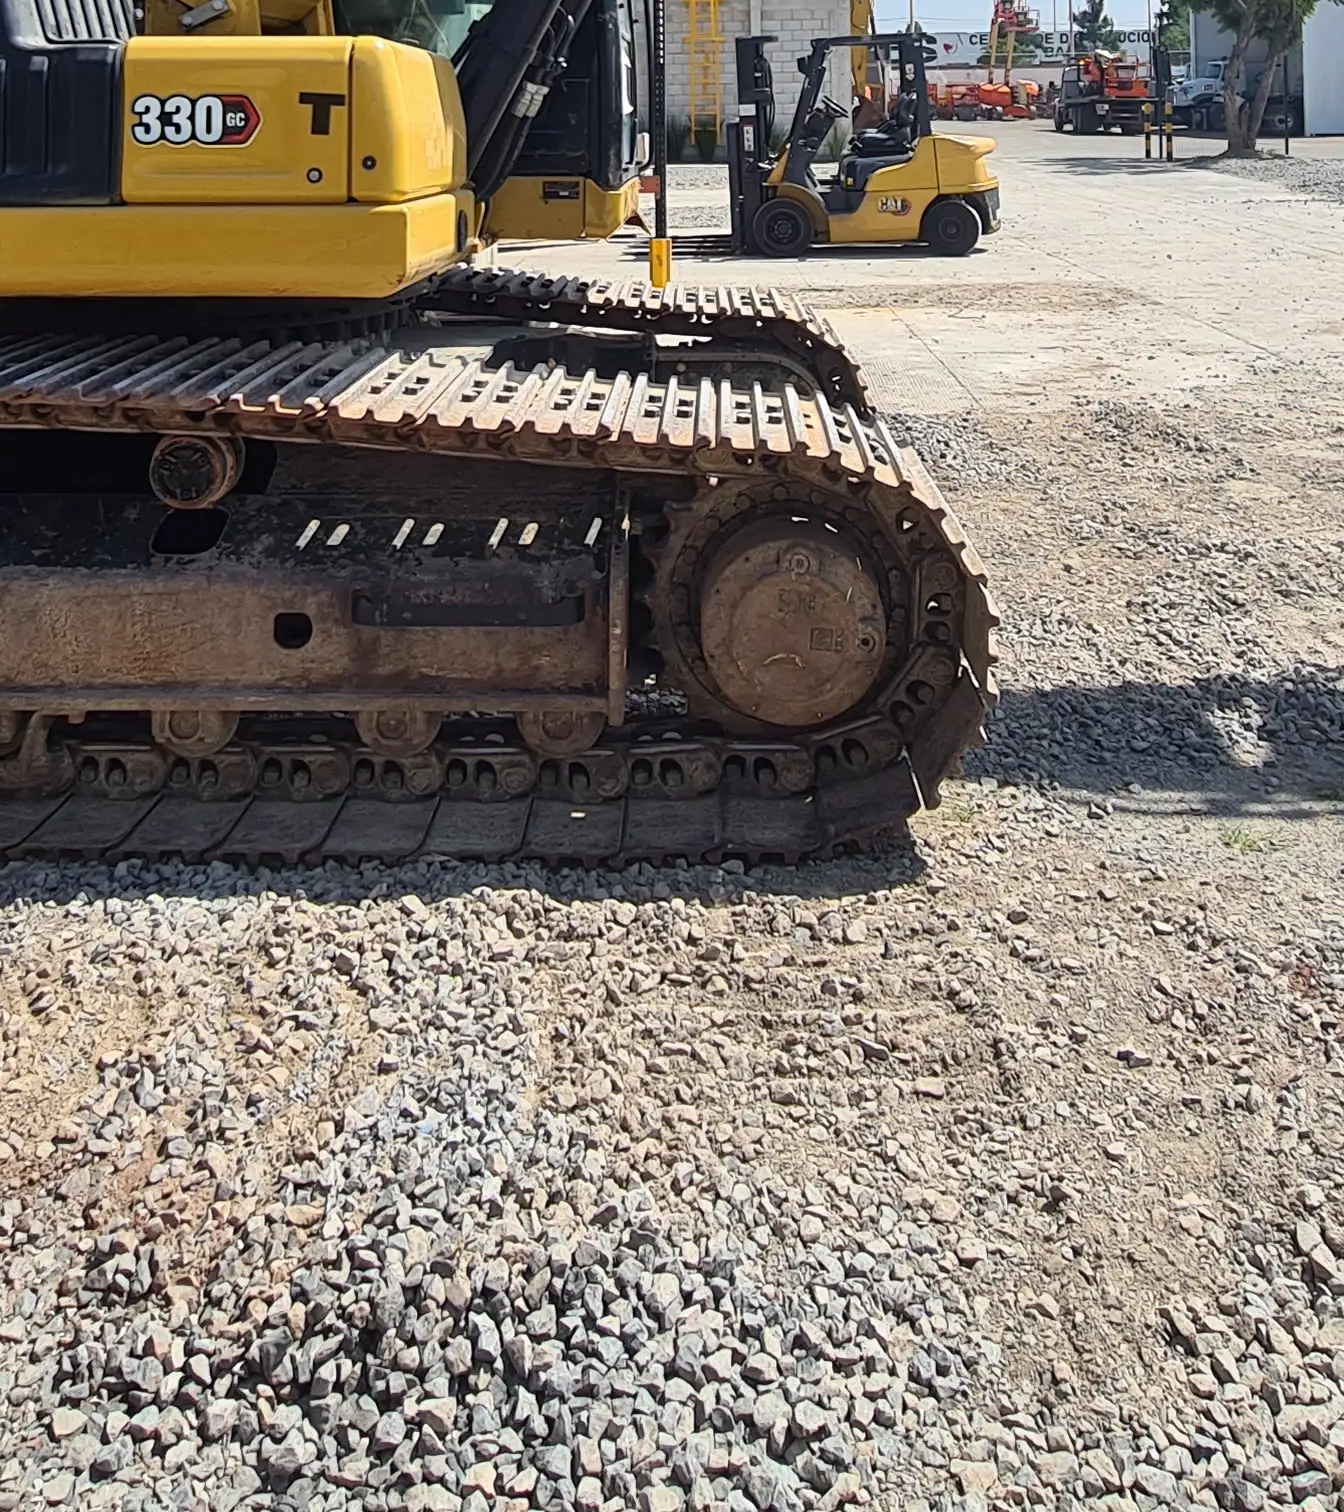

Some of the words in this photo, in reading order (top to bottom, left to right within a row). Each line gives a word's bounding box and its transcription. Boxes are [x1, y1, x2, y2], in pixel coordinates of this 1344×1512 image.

[133, 95, 224, 143] 330
[225, 112, 246, 127] GC
[299, 92, 346, 135] T
[878, 196, 904, 212] CAT
